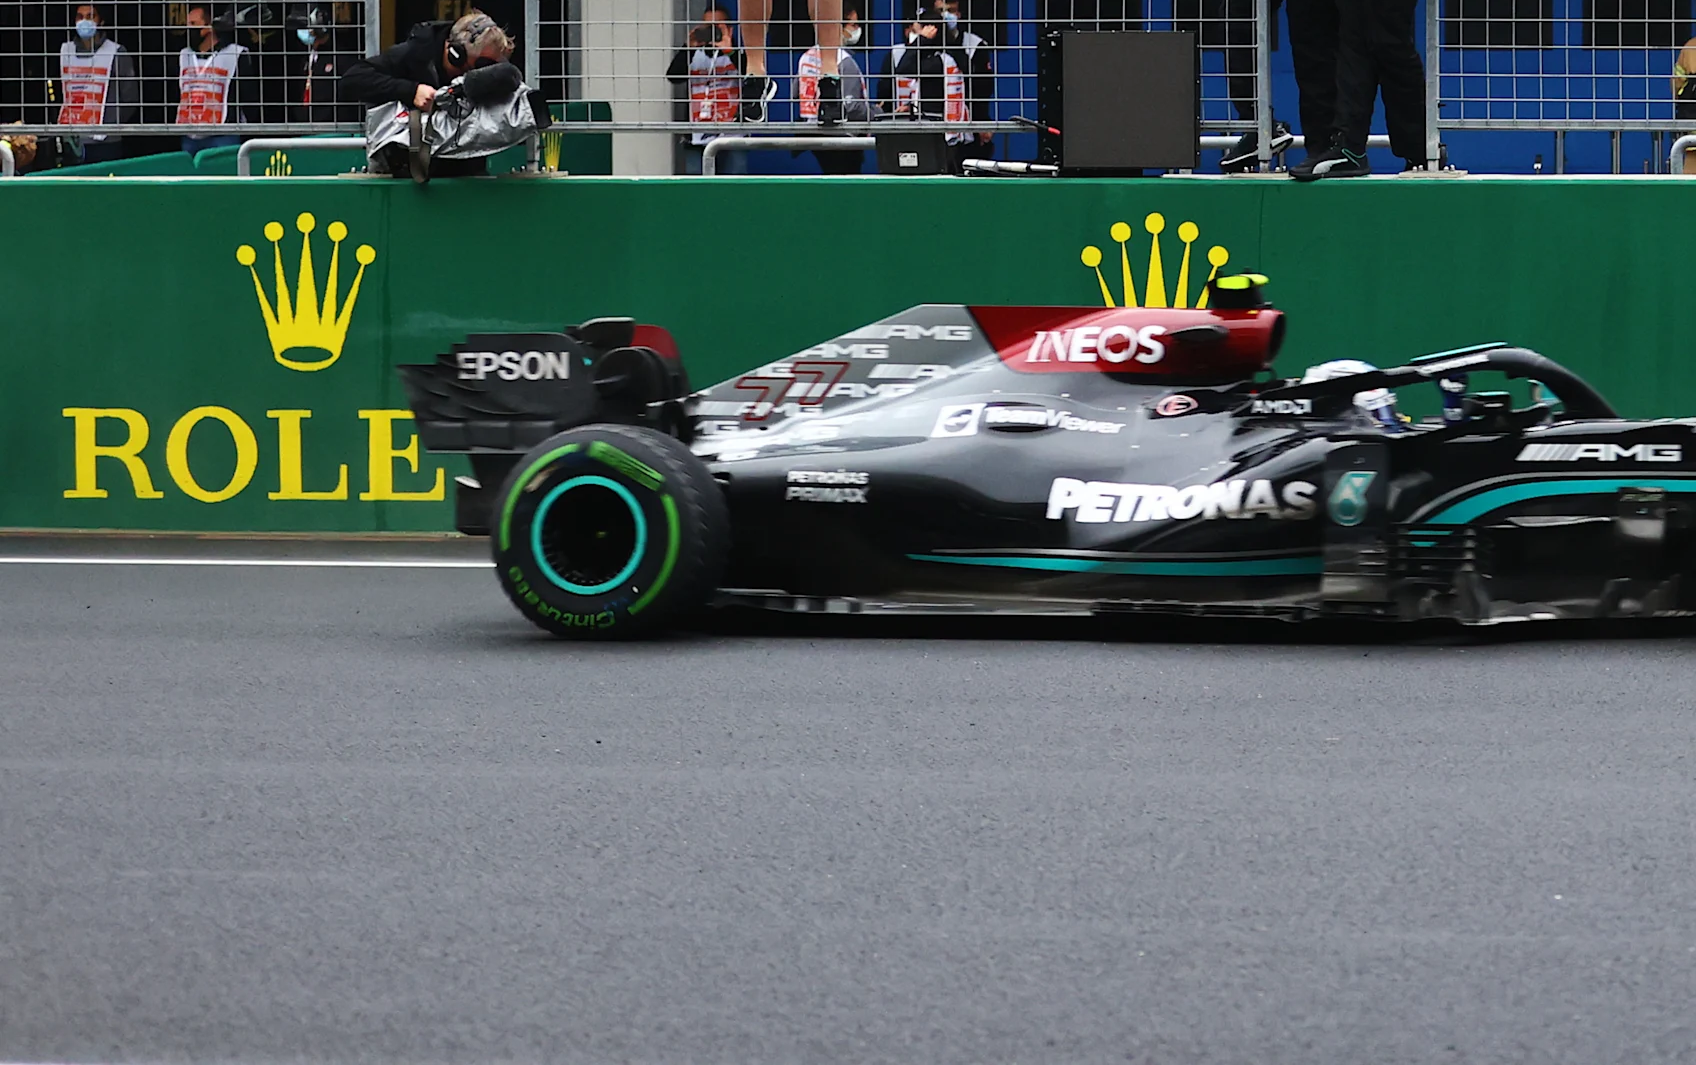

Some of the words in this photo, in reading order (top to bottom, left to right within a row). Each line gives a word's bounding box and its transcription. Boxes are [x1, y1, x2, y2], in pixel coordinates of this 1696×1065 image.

[1026, 326, 1168, 365] INEOS
[456, 351, 570, 381] EPSON
[733, 361, 851, 421] 77
[985, 405, 1127, 434] TeamViewer
[62, 406, 445, 503] ROLE
[1576, 443, 1682, 462] AMG
[1046, 477, 1318, 524] PETRONAS
